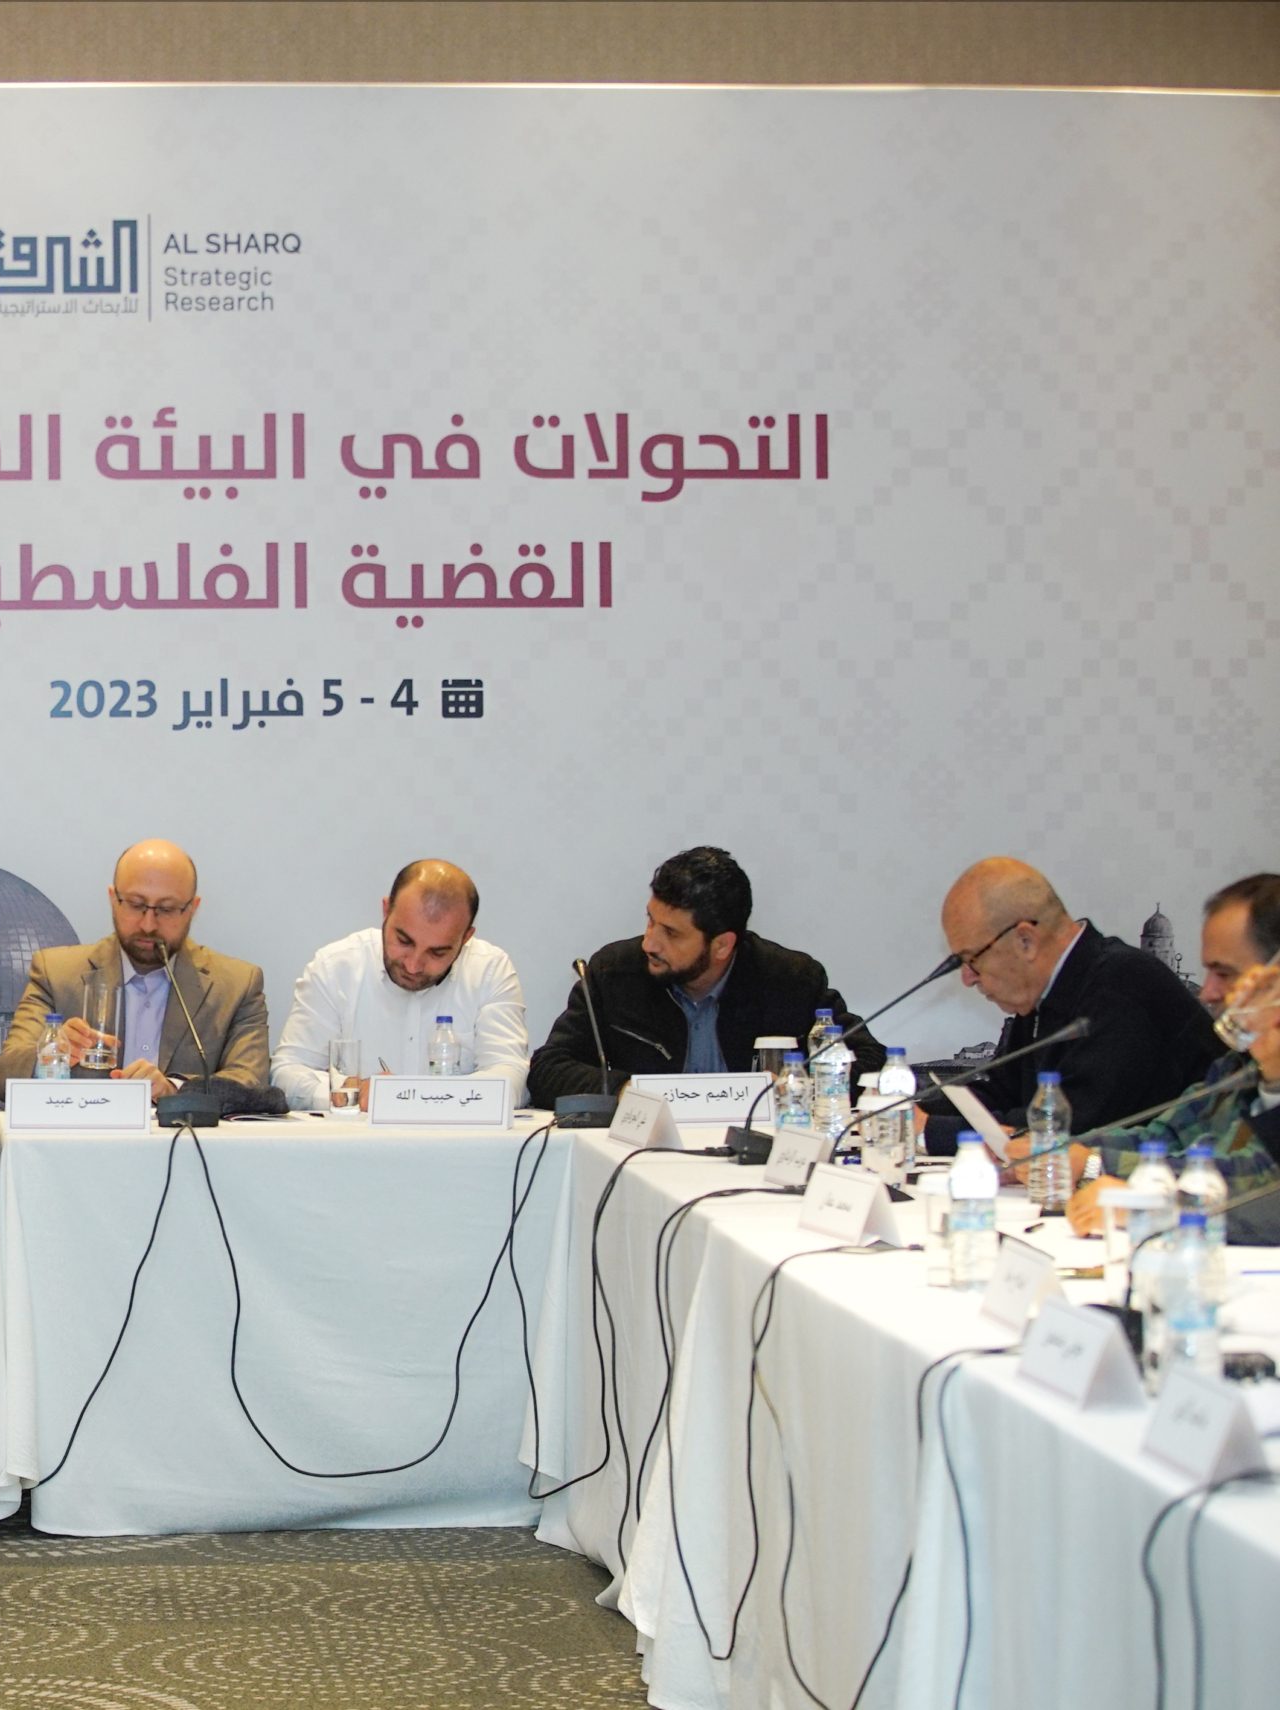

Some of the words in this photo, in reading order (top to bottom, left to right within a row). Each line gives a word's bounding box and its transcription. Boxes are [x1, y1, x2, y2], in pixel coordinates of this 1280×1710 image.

[164, 234, 198, 254] AL
[205, 232, 303, 255] SHARQ
[164, 266, 273, 291] Strategic
[164, 290, 274, 312] Research
[96, 407, 305, 500] البيئة
[341, 414, 480, 499] في
[514, 413, 828, 502] التحولات
[342, 542, 612, 628] القضية
[50, 680, 157, 718] 2023
[173, 678, 303, 730] فبراير
[323, 679, 343, 716] 5
[391, 679, 418, 715] 4
[78, 1096, 111, 1109] حسن
[395, 1088, 416, 1101] الله
[420, 1092, 455, 1104] حبيب
[459, 1089, 483, 1107] علي
